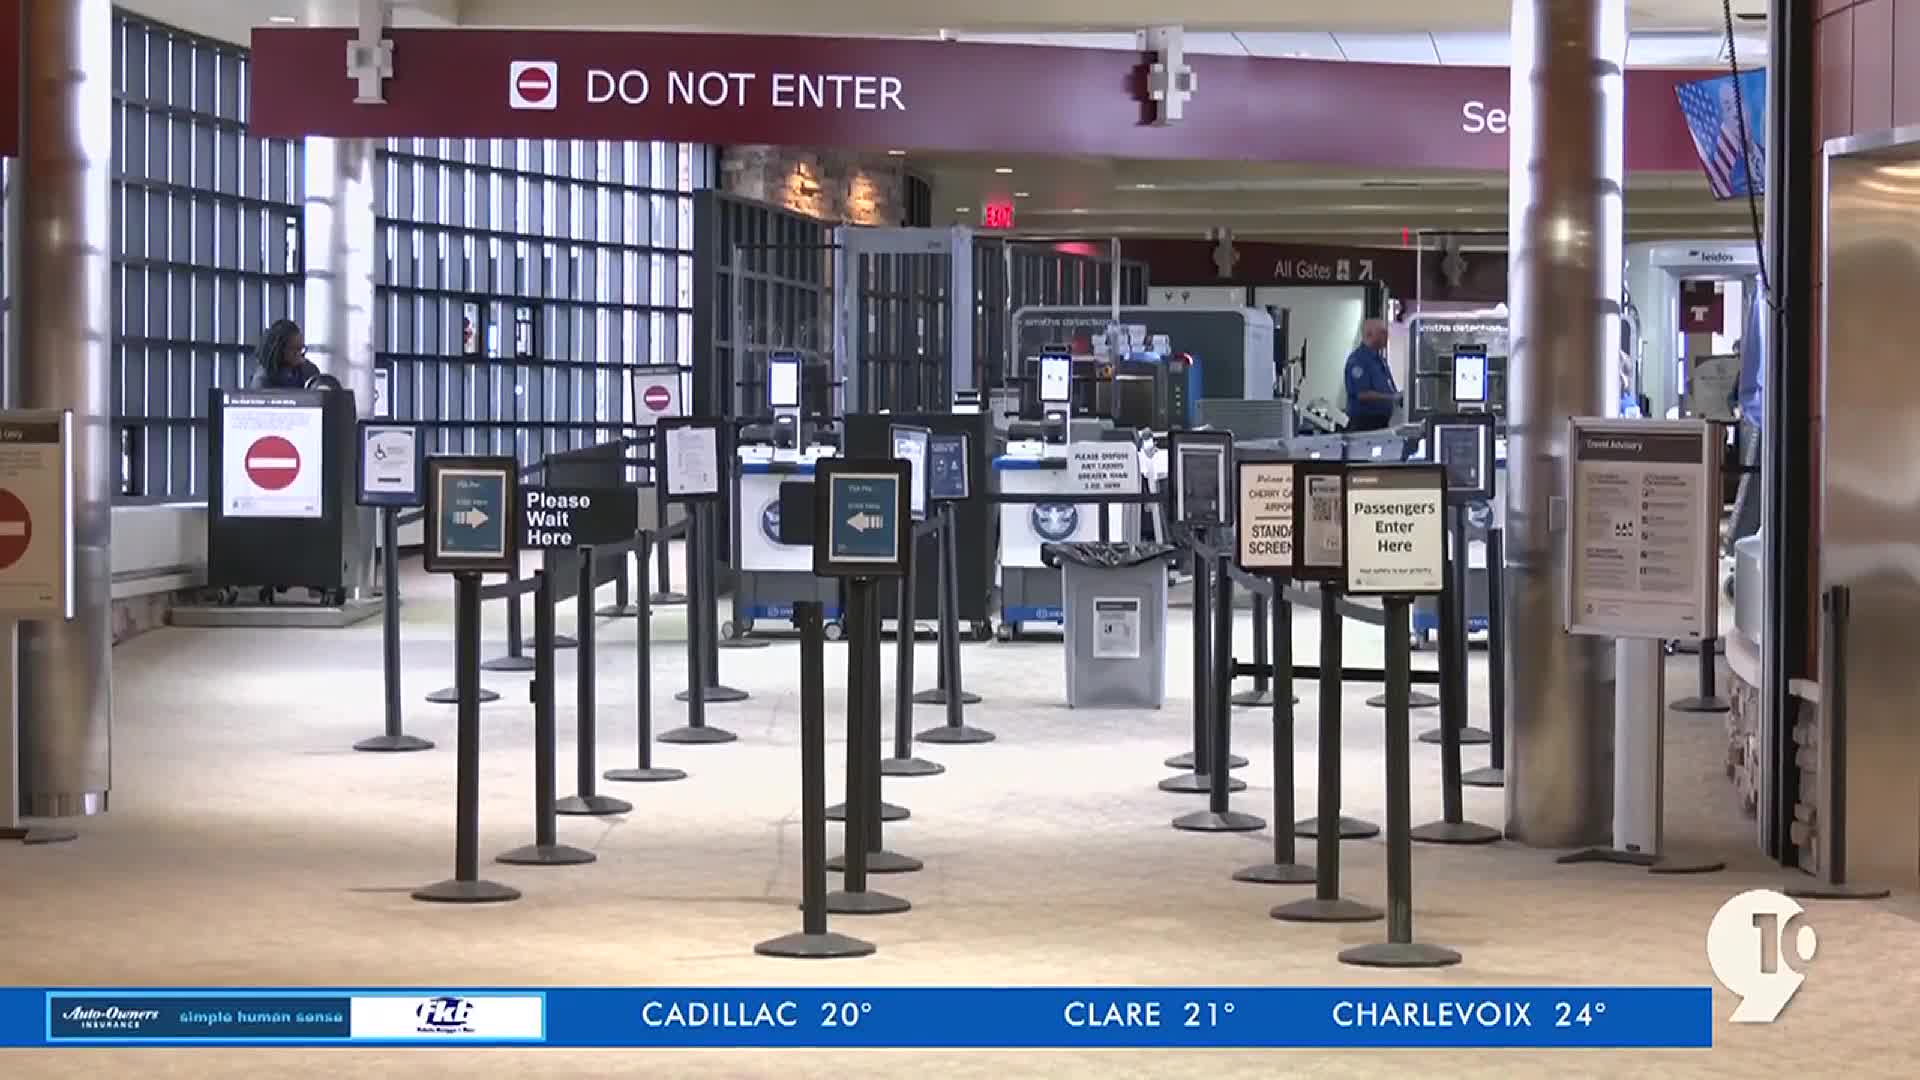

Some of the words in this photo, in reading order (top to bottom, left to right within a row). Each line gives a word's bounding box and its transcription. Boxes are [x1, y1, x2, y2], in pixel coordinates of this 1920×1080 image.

[586, 69, 649, 105] DO
[667, 71, 755, 107] NOT
[771, 73, 906, 111] ENTER
[1462, 100, 1511, 134] Se
[985, 205, 1012, 227] EXIT
[1701, 252, 1733, 262] leidos
[1273, 260, 1292, 279] All
[1296, 260, 1331, 279] Gates
[526, 492, 591, 509] Please
[1248, 490, 1280, 498] CHERRY
[1354, 502, 1436, 516] Passengers
[526, 511, 570, 527] Wait
[1375, 520, 1415, 534] Enter
[527, 530, 573, 545] Here
[1378, 540, 1413, 553] Here
